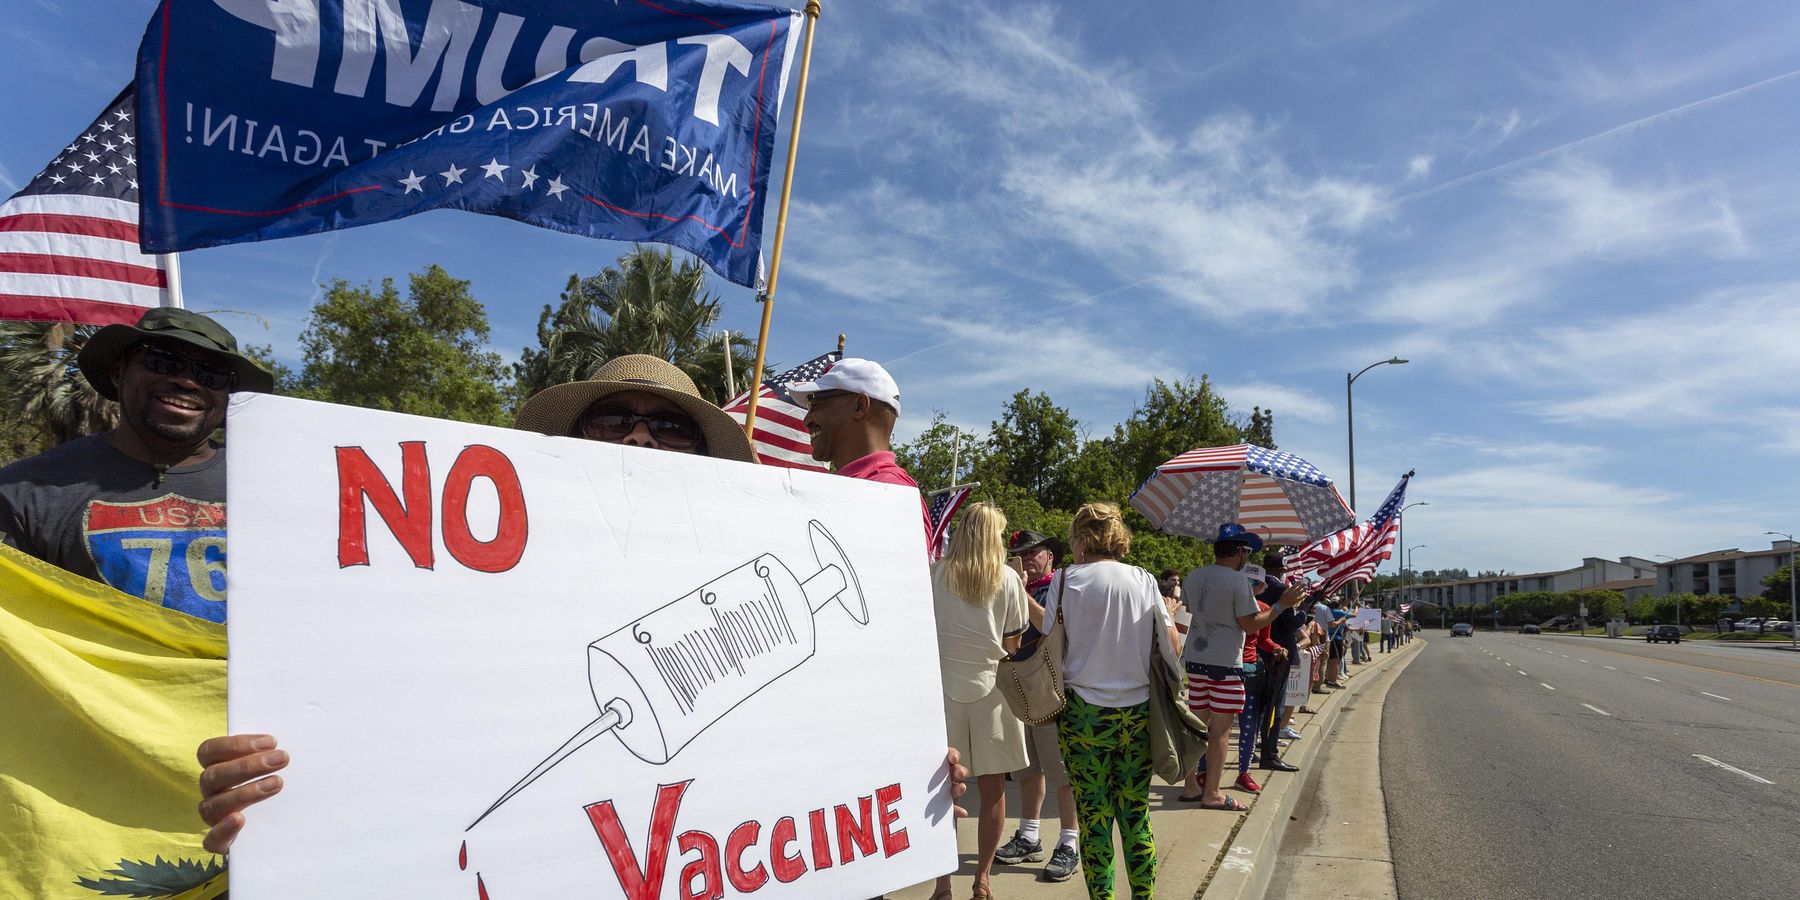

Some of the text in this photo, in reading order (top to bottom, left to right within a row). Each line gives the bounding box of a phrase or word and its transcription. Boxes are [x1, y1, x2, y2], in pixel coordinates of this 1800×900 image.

[138, 508, 212, 525] USA
[336, 440, 529, 573] NO
[122, 537, 226, 608] 76
[632, 559, 770, 645] 6 6 6
